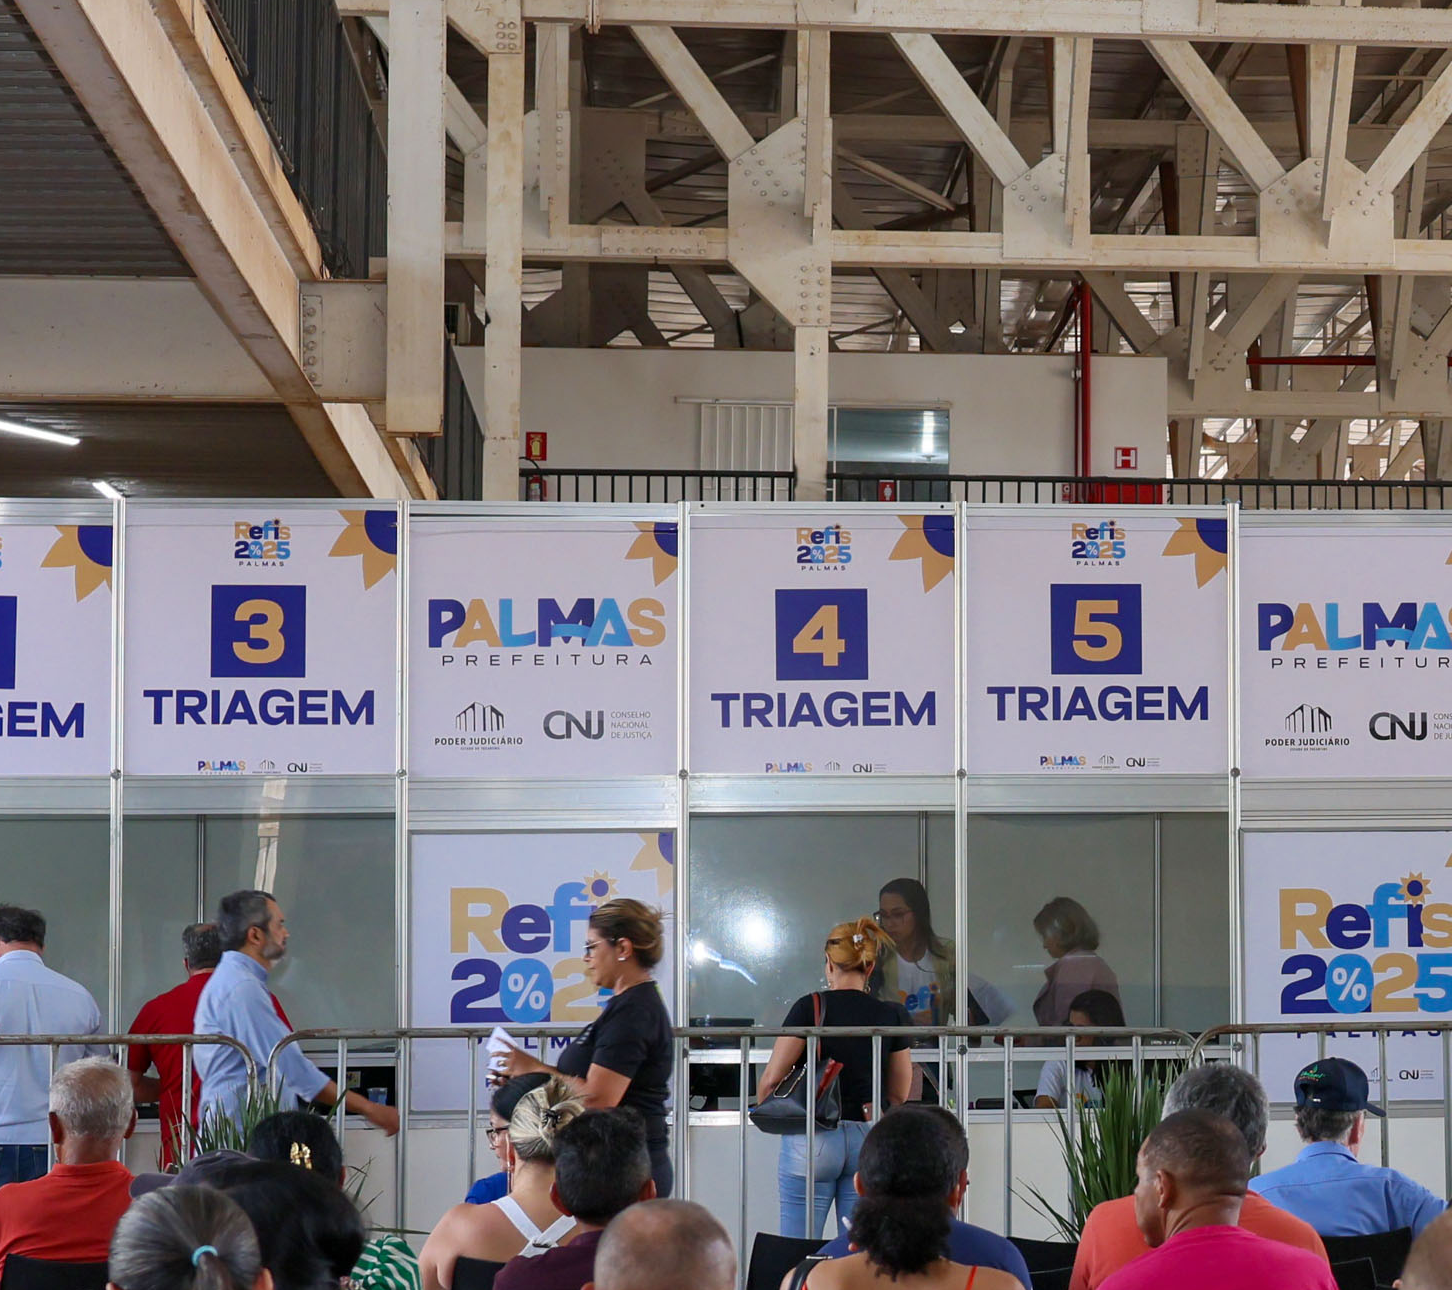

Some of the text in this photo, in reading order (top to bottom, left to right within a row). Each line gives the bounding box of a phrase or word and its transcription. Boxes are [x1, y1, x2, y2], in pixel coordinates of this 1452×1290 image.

[234, 518, 291, 540] Refis
[796, 524, 851, 545] Refis
[1071, 520, 1125, 540] Refis
[233, 599, 285, 664] 3
[428, 598, 665, 648] PALMAS
[1072, 600, 1122, 661] 5
[793, 605, 845, 666] 4
[443, 654, 652, 666] PREFEITURA
[143, 689, 374, 725] TRIAGEM
[711, 691, 936, 728] TRIAGEM
[987, 686, 1208, 721] TRIAGEM
[543, 710, 604, 739] CNJ
[611, 711, 650, 719] CONSELHO
[622, 731, 652, 740] JUSTIÇA
[1369, 712, 1427, 740] CNJ
[469, 736, 522, 746] JUDICIÁRIO
[1299, 737, 1349, 746] JUDICIÁRIO
[198, 760, 245, 771] PALMAS
[287, 763, 307, 773] CNJ
[765, 762, 812, 772] PALMAS
[853, 764, 872, 773] CNJ
[1040, 756, 1086, 766] PALMAS
[1126, 758, 1145, 767] CNJ
[451, 958, 614, 1023] 202
[1399, 1070, 1419, 1080] CNJ
